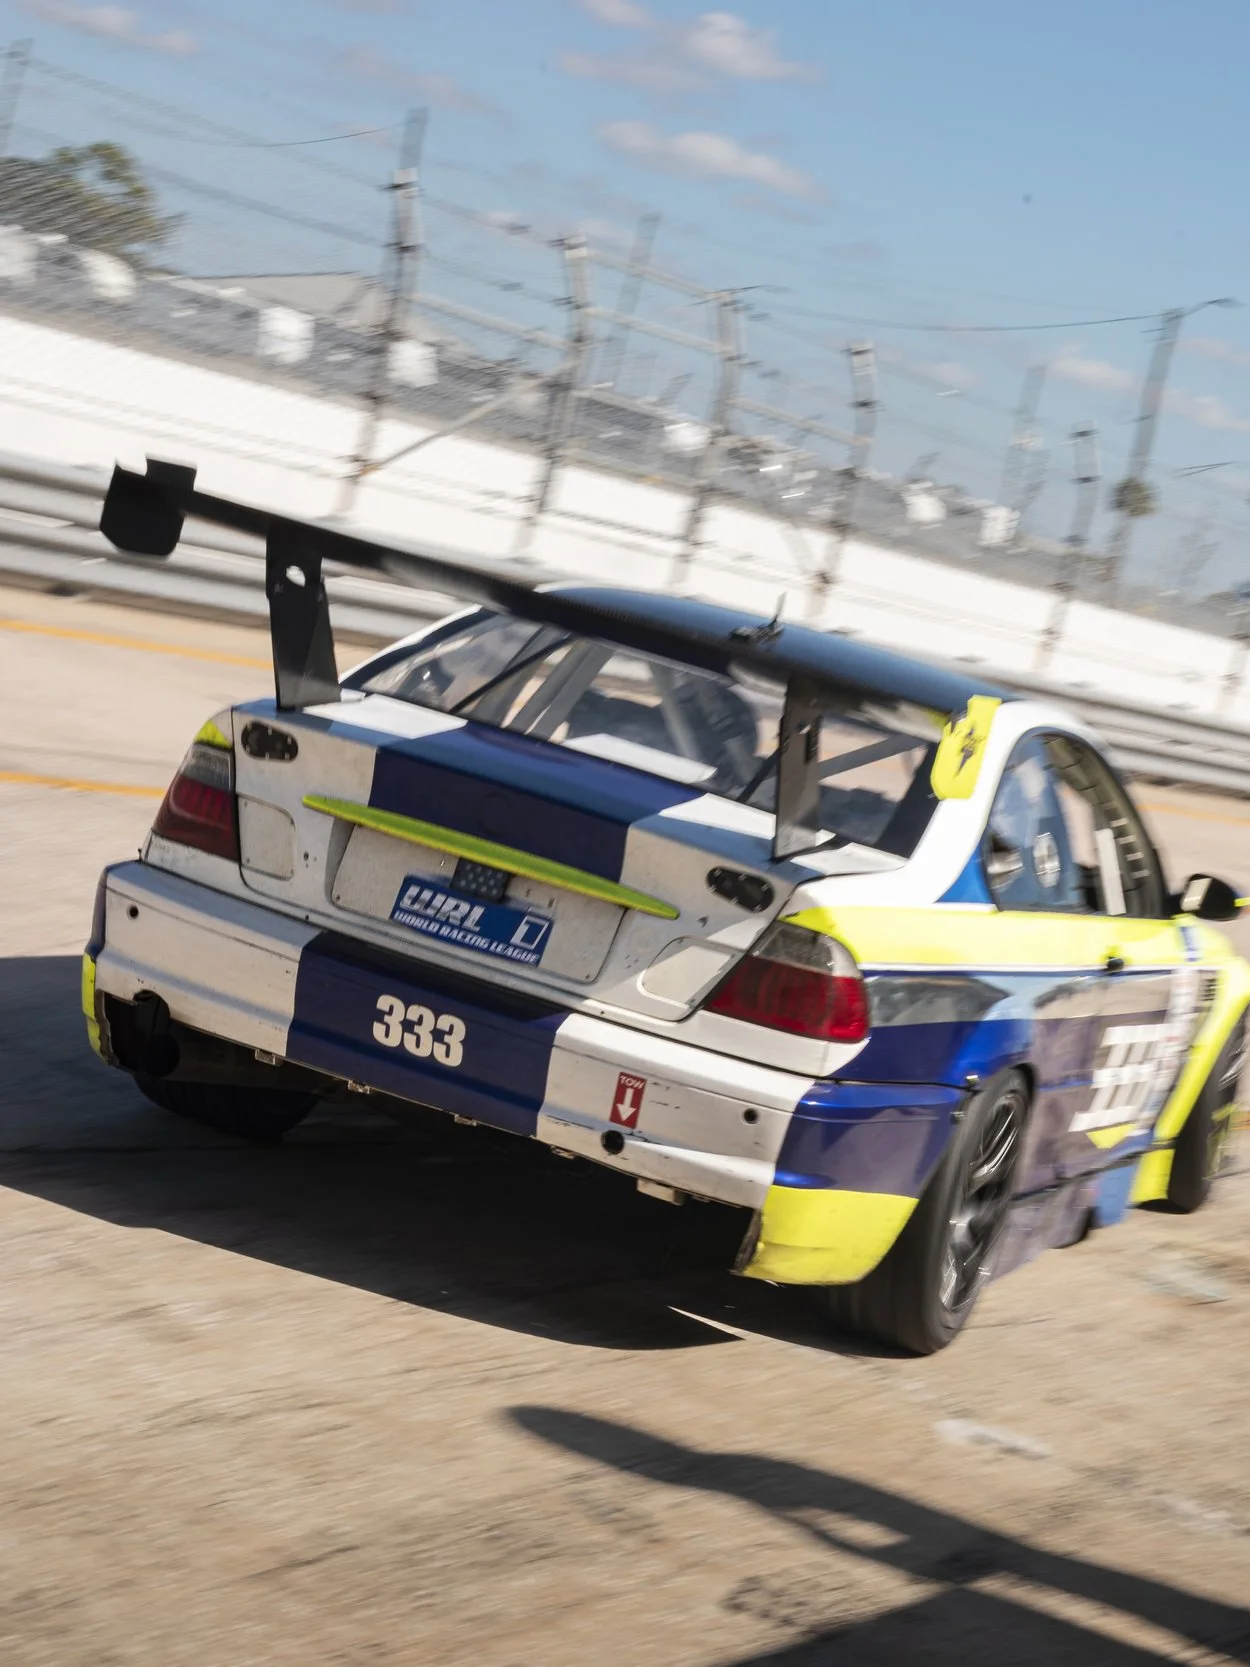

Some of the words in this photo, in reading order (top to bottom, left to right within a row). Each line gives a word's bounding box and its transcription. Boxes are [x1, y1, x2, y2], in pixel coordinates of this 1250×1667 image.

[400, 885, 486, 932] WRL
[393, 909, 441, 934] WORLD
[438, 925, 491, 949] RACING
[489, 940, 541, 965] LEAGUE
[373, 994, 466, 1067] 333
[619, 1075, 646, 1089] TOW
